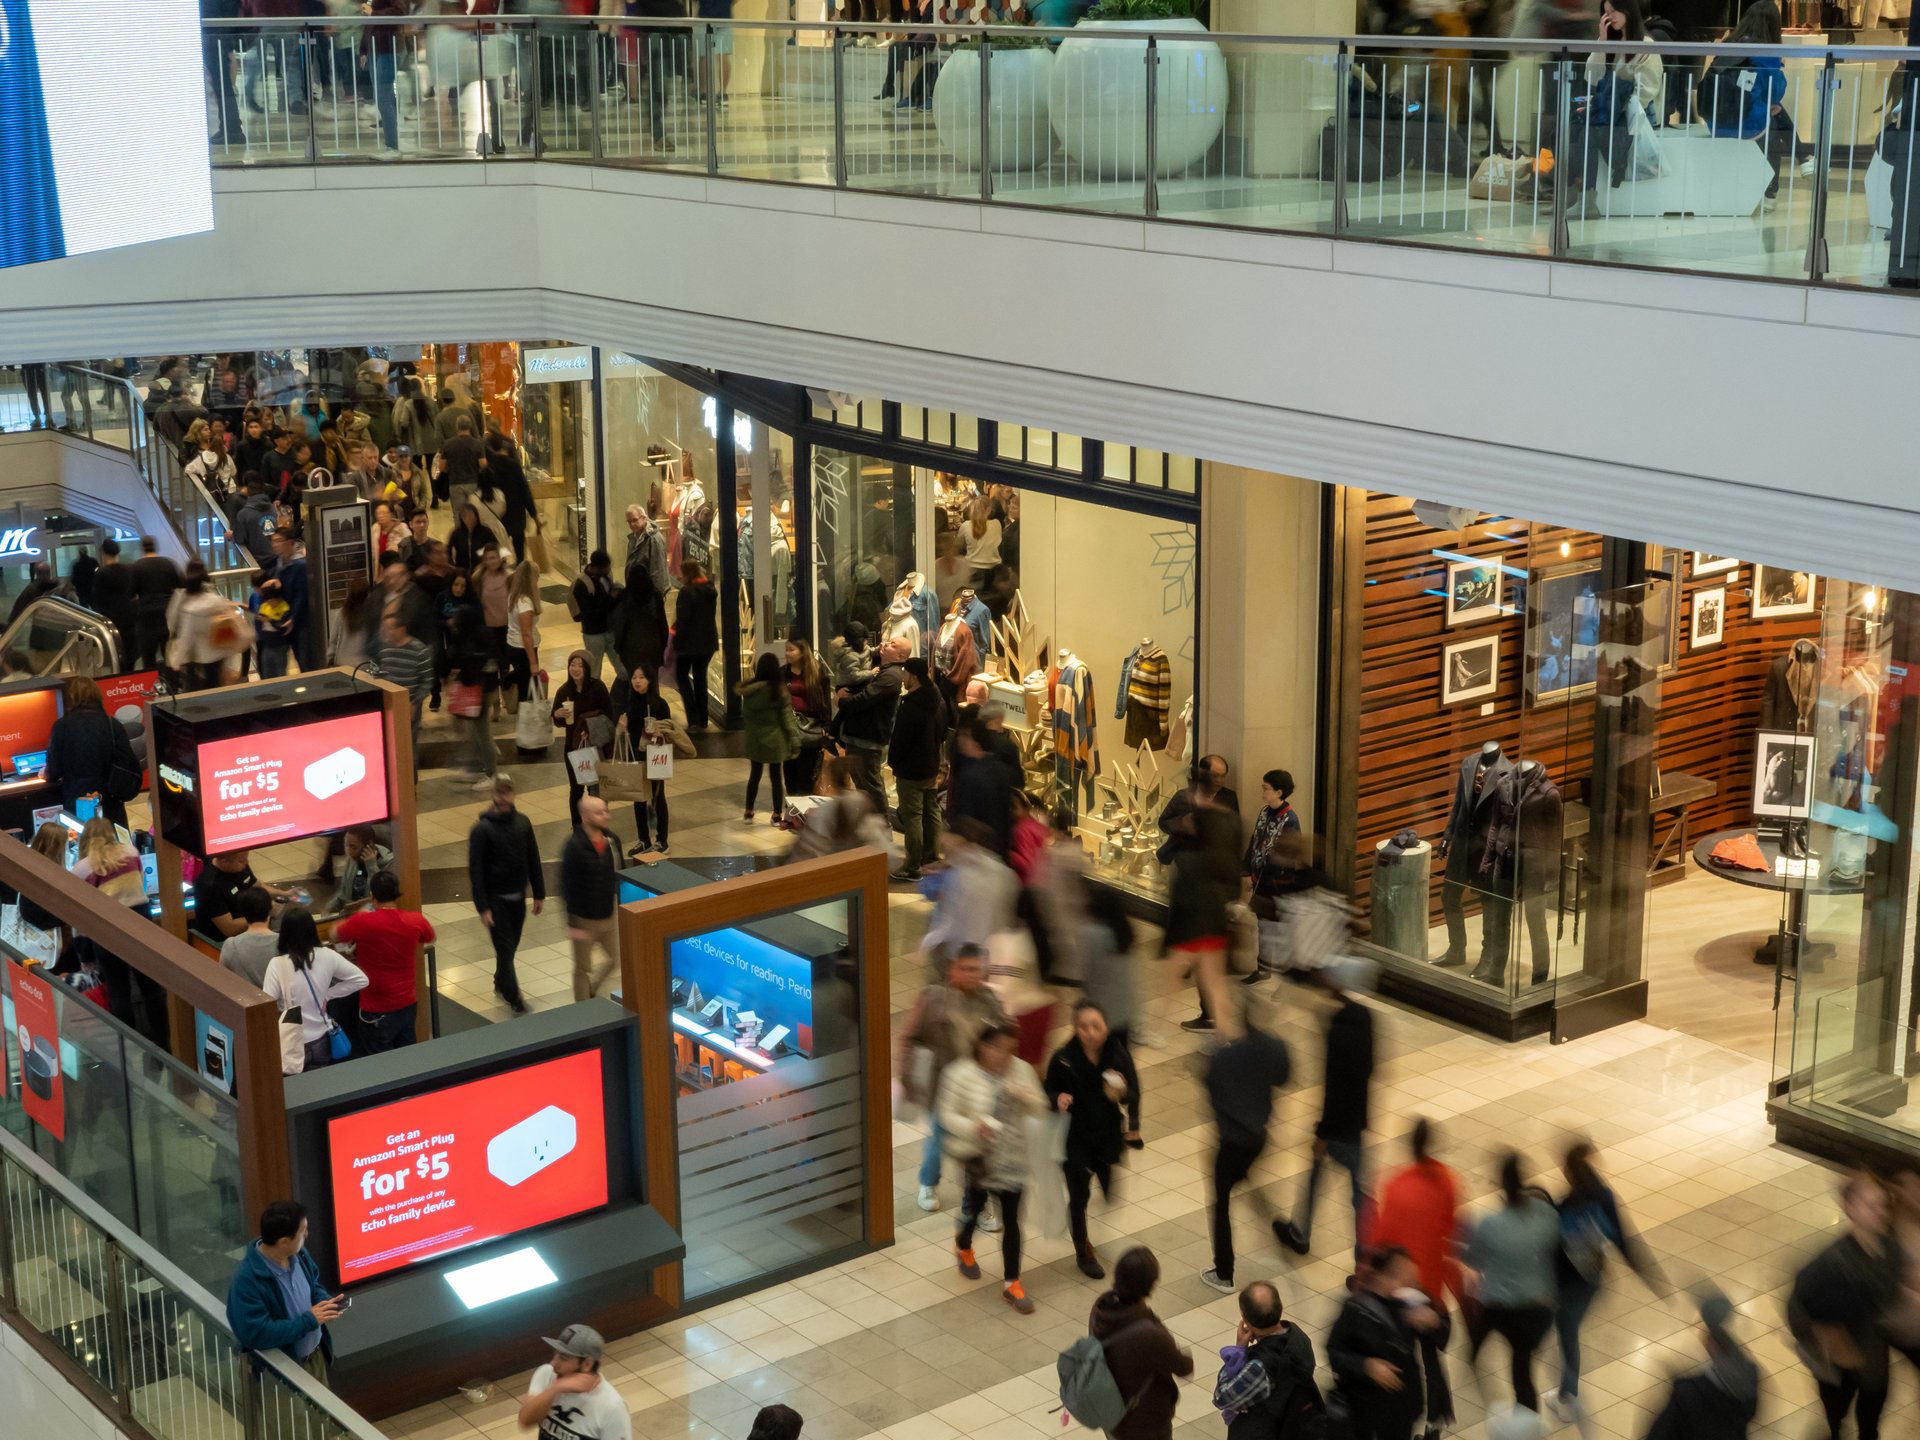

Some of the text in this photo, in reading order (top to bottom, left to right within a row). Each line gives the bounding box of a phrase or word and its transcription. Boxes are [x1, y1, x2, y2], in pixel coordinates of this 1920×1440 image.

[1478, 176, 1509, 186] adidas
[528, 355, 588, 374] Madewell
[106, 683, 144, 697] echo dot
[214, 760, 282, 779] Amazon Smart Plug
[236, 755, 259, 765] Get an
[219, 771, 279, 800] for $5
[220, 804, 284, 822] Echo family device
[703, 940, 735, 965] devices
[736, 953, 749, 971] for
[750, 964, 786, 991] reading.
[19, 980, 33, 995] echo
[33, 986, 44, 1003] dot
[386, 1129, 420, 1146] Get an
[353, 1133, 455, 1168] Amazon Smart Plug
[360, 1151, 450, 1200] for $5
[369, 1189, 446, 1217] with the purchase of any
[361, 1198, 456, 1233] Echo family device
